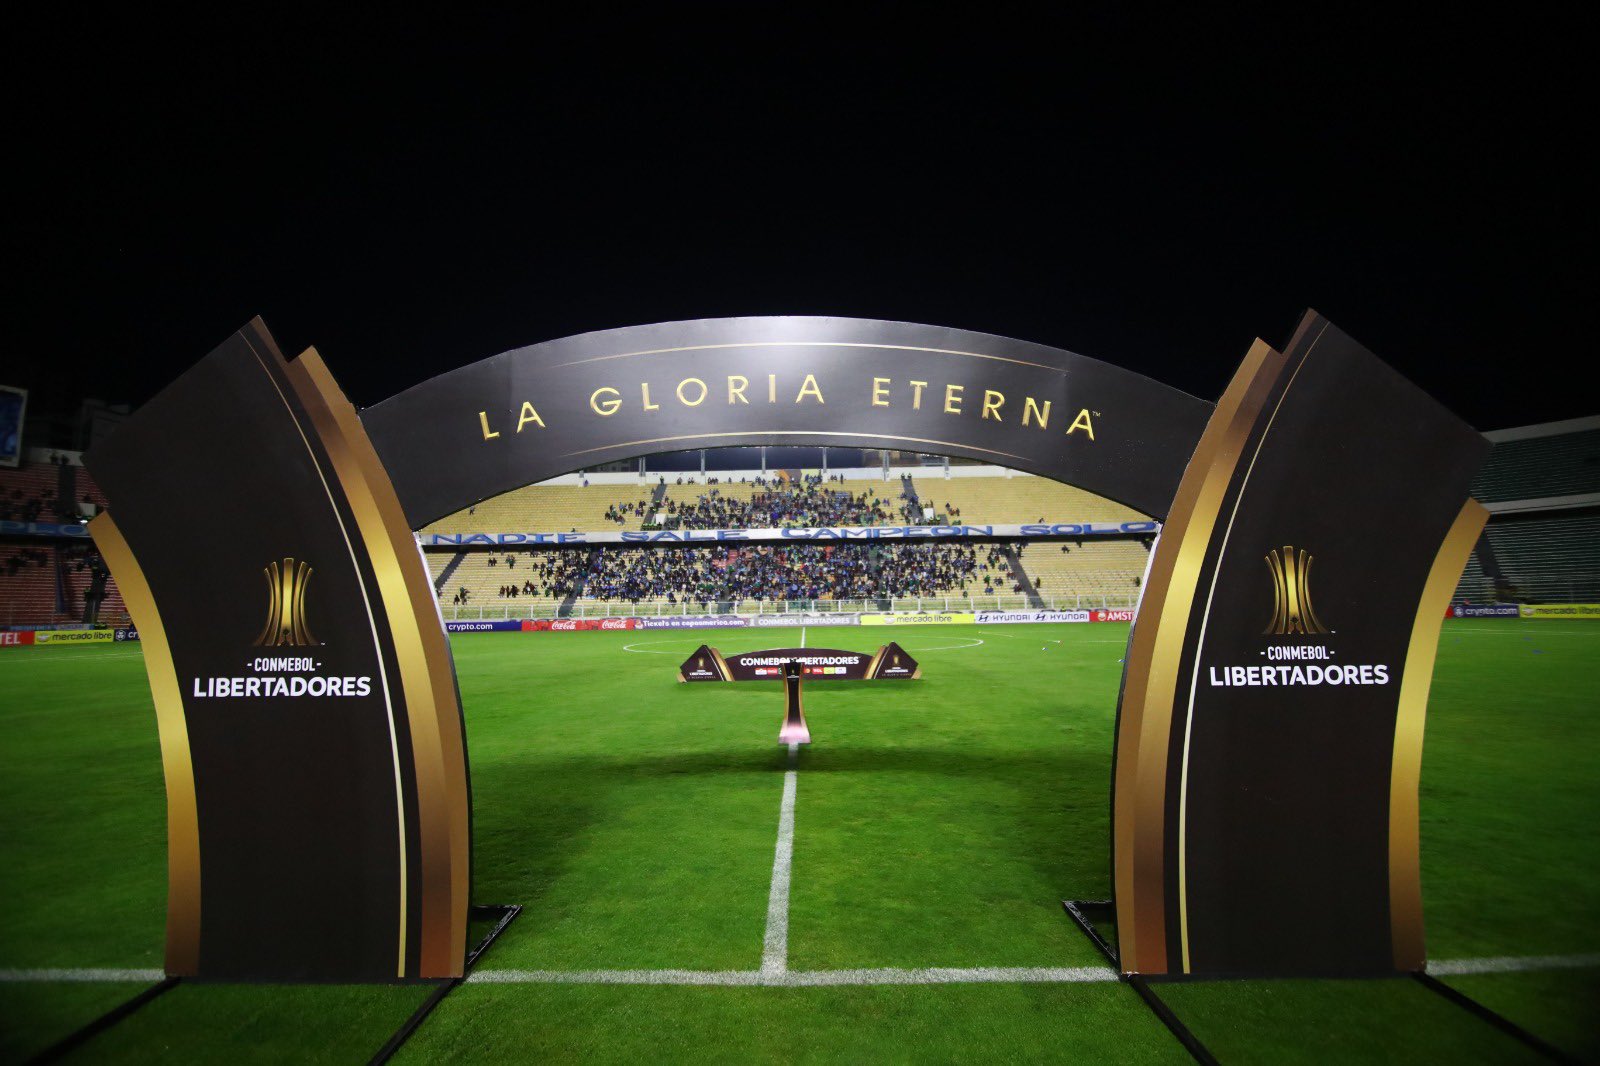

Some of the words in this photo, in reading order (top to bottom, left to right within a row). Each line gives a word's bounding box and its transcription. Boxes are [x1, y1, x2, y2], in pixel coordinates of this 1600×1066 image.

[478, 401, 546, 441] LA
[590, 374, 825, 416] GLORIA
[872, 377, 1095, 441] ETERNA
[432, 533, 586, 545] NADIE
[621, 530, 749, 542] SALE
[781, 526, 993, 538] CAMPEON
[1020, 521, 1157, 535] SOLO
[896, 615, 933, 623] mercado
[1106, 611, 1134, 621] AMST
[758, 618, 798, 626] CONMEBOL
[799, 617, 850, 625] LIBERTADORES
[448, 622, 493, 632] crypto.com
[52, 633, 92, 641] mercado
[93, 631, 112, 639] libre
[1209, 665, 1389, 686] LIBERTADORES
[193, 676, 371, 697] LIBERTADORES
